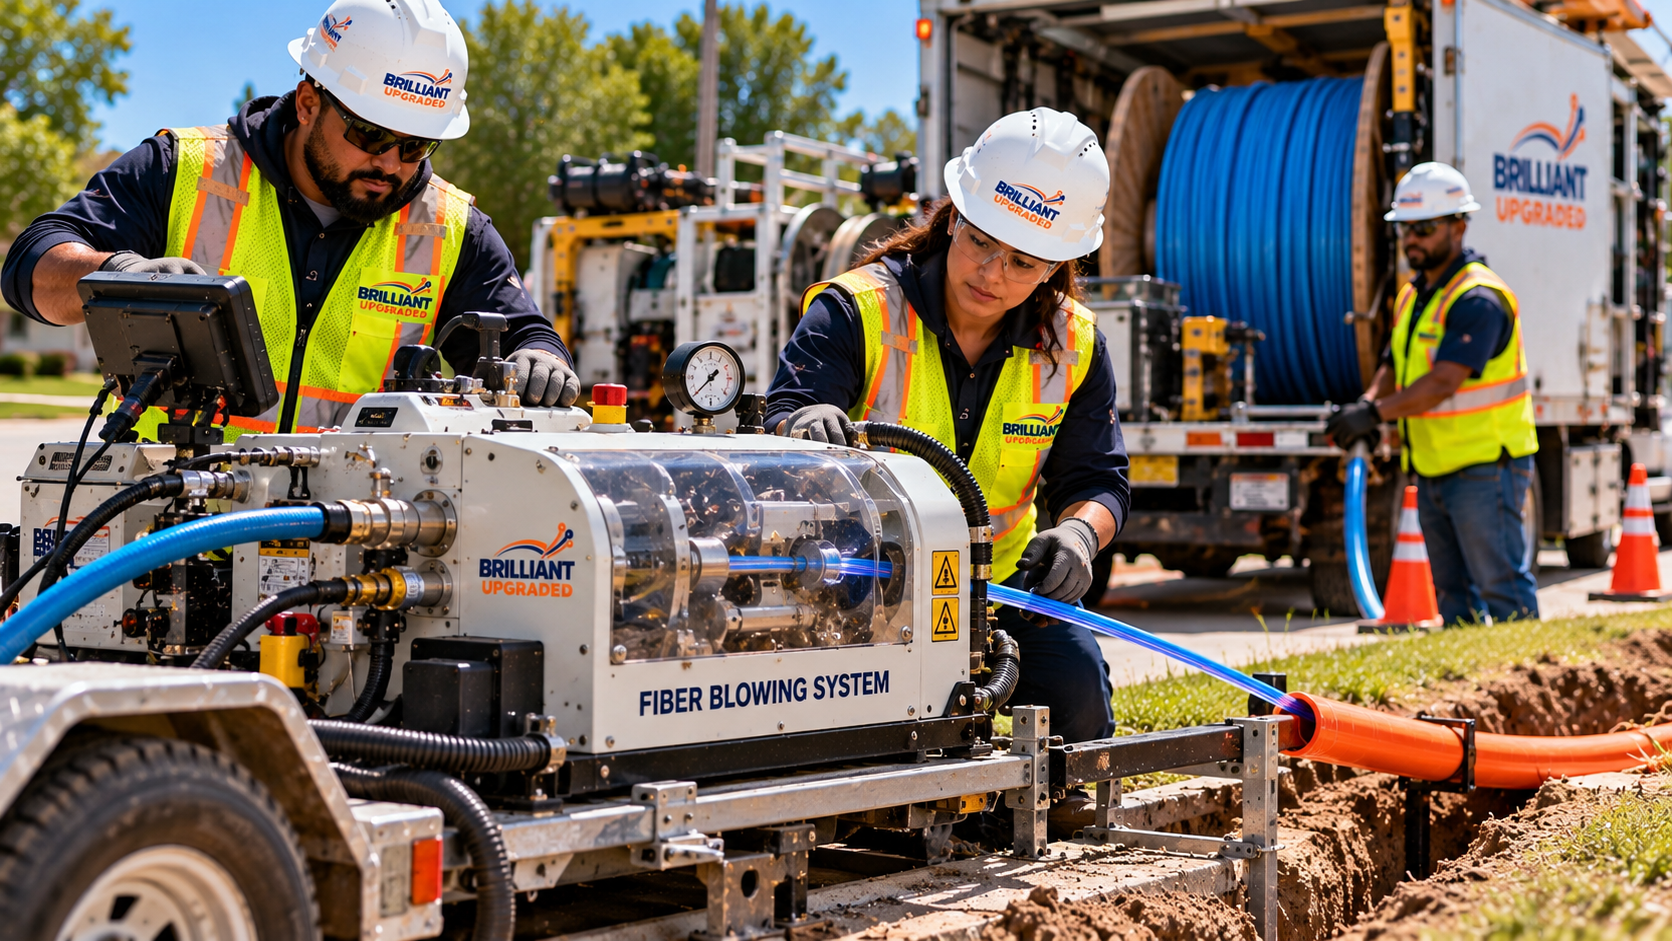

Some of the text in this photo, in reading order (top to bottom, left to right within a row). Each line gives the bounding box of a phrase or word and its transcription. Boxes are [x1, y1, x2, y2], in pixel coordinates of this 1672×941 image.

[383, 72, 451, 100] BRILLIANT
[384, 86, 446, 108] UPGRADED
[1494, 154, 1587, 201] BRILLIANT
[995, 180, 1060, 221] BRILLIANT
[1496, 196, 1587, 231] UPGRADED
[358, 286, 432, 310] BRILLIANT
[479, 558, 575, 580] BRILLIANT
[482, 580, 573, 598] UPGRADED
[639, 670, 890, 717] FIBER BLOWING SYSTEM
